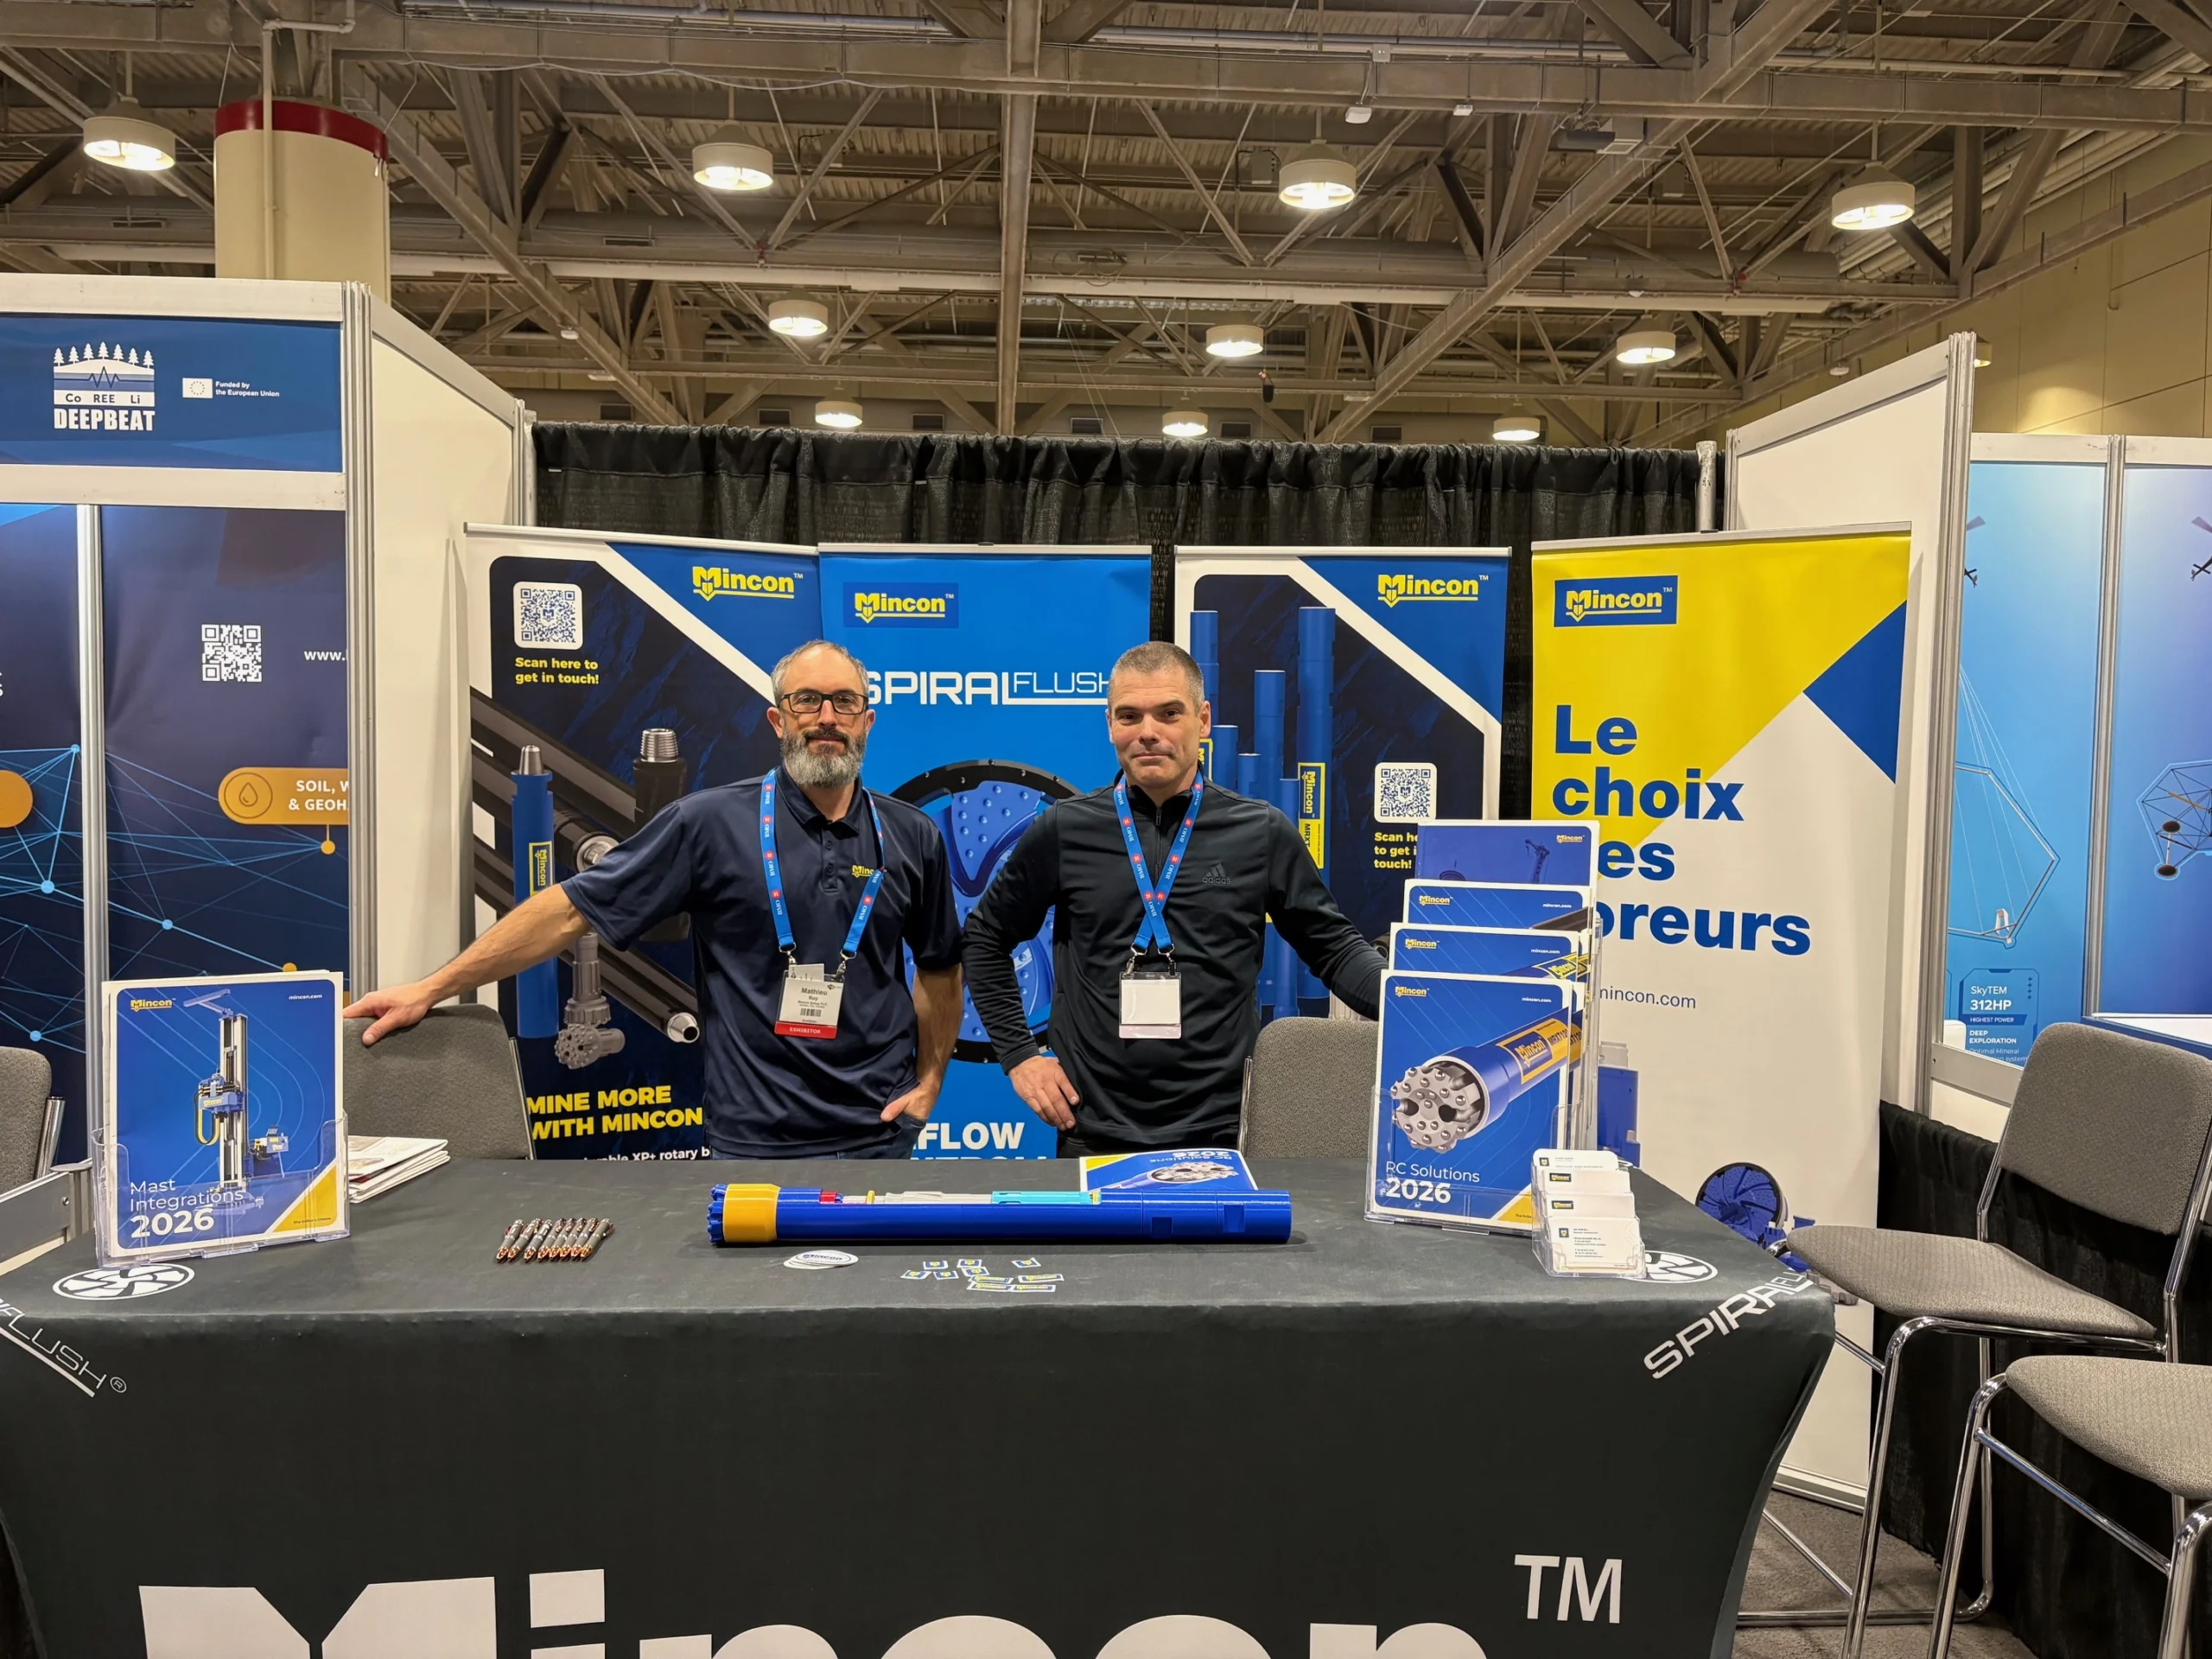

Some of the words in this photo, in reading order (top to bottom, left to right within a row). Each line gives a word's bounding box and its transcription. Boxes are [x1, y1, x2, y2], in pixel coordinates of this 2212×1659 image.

[216, 381, 239, 390] Funded
[241, 382, 250, 391] by
[228, 389, 258, 398] European
[66, 393, 81, 404] Co
[93, 394, 115, 404] REE
[130, 394, 141, 404] Li
[54, 408, 156, 431] DEEPBEAT
[692, 566, 794, 600] Mincon
[1378, 574, 1478, 607] Mincon
[855, 593, 945, 622] Mincon
[1566, 588, 1662, 620] Mincon
[304, 649, 348, 662] www.
[515, 657, 548, 669] Scan
[551, 658, 582, 670] here
[584, 659, 598, 670] to
[516, 673, 538, 685] get
[542, 673, 555, 683] in
[558, 673, 600, 684] touch!
[1555, 704, 1638, 756] Le
[296, 780, 335, 794] SOIL,
[1302, 771, 1315, 814] Mincon
[1552, 766, 1745, 822] choix
[289, 798, 300, 810] &
[305, 799, 348, 811] GEOH
[1374, 832, 1403, 842] Scan
[1374, 846, 1387, 855] to
[1390, 846, 1410, 857] get
[1598, 841, 1675, 881] es
[535, 849, 547, 886] Mincon
[852, 865, 874, 876] Minc
[1374, 859, 1412, 869] touch!
[1203, 876, 1231, 885] adidas
[1419, 895, 1450, 906] Mincon
[1596, 900, 1811, 956] reurs
[1405, 938, 1437, 949] Mincon
[1395, 986, 1427, 996] Mincon
[1971, 986, 2007, 996] SkyTEM
[130, 998, 172, 1011] Mincon
[1970, 1000, 2012, 1010] 312HP
[526, 1092, 590, 1115] MINE
[598, 1085, 671, 1109] MORE
[532, 1116, 594, 1140] WITH
[602, 1107, 703, 1134] MINCON
[912, 1122, 1025, 1150] FLOW
[659, 1148, 698, 1160] rotary
[1386, 1161, 1407, 1175] RC
[1410, 1164, 1480, 1183] Solutions
[130, 1179, 175, 1194] Mast
[1386, 1178, 1452, 1204] 2026
[130, 1189, 244, 1211] Integrations
[130, 1206, 214, 1238] 2026
[0, 1302, 107, 1389] FLUSH
[1514, 1554, 1624, 1624] TM
